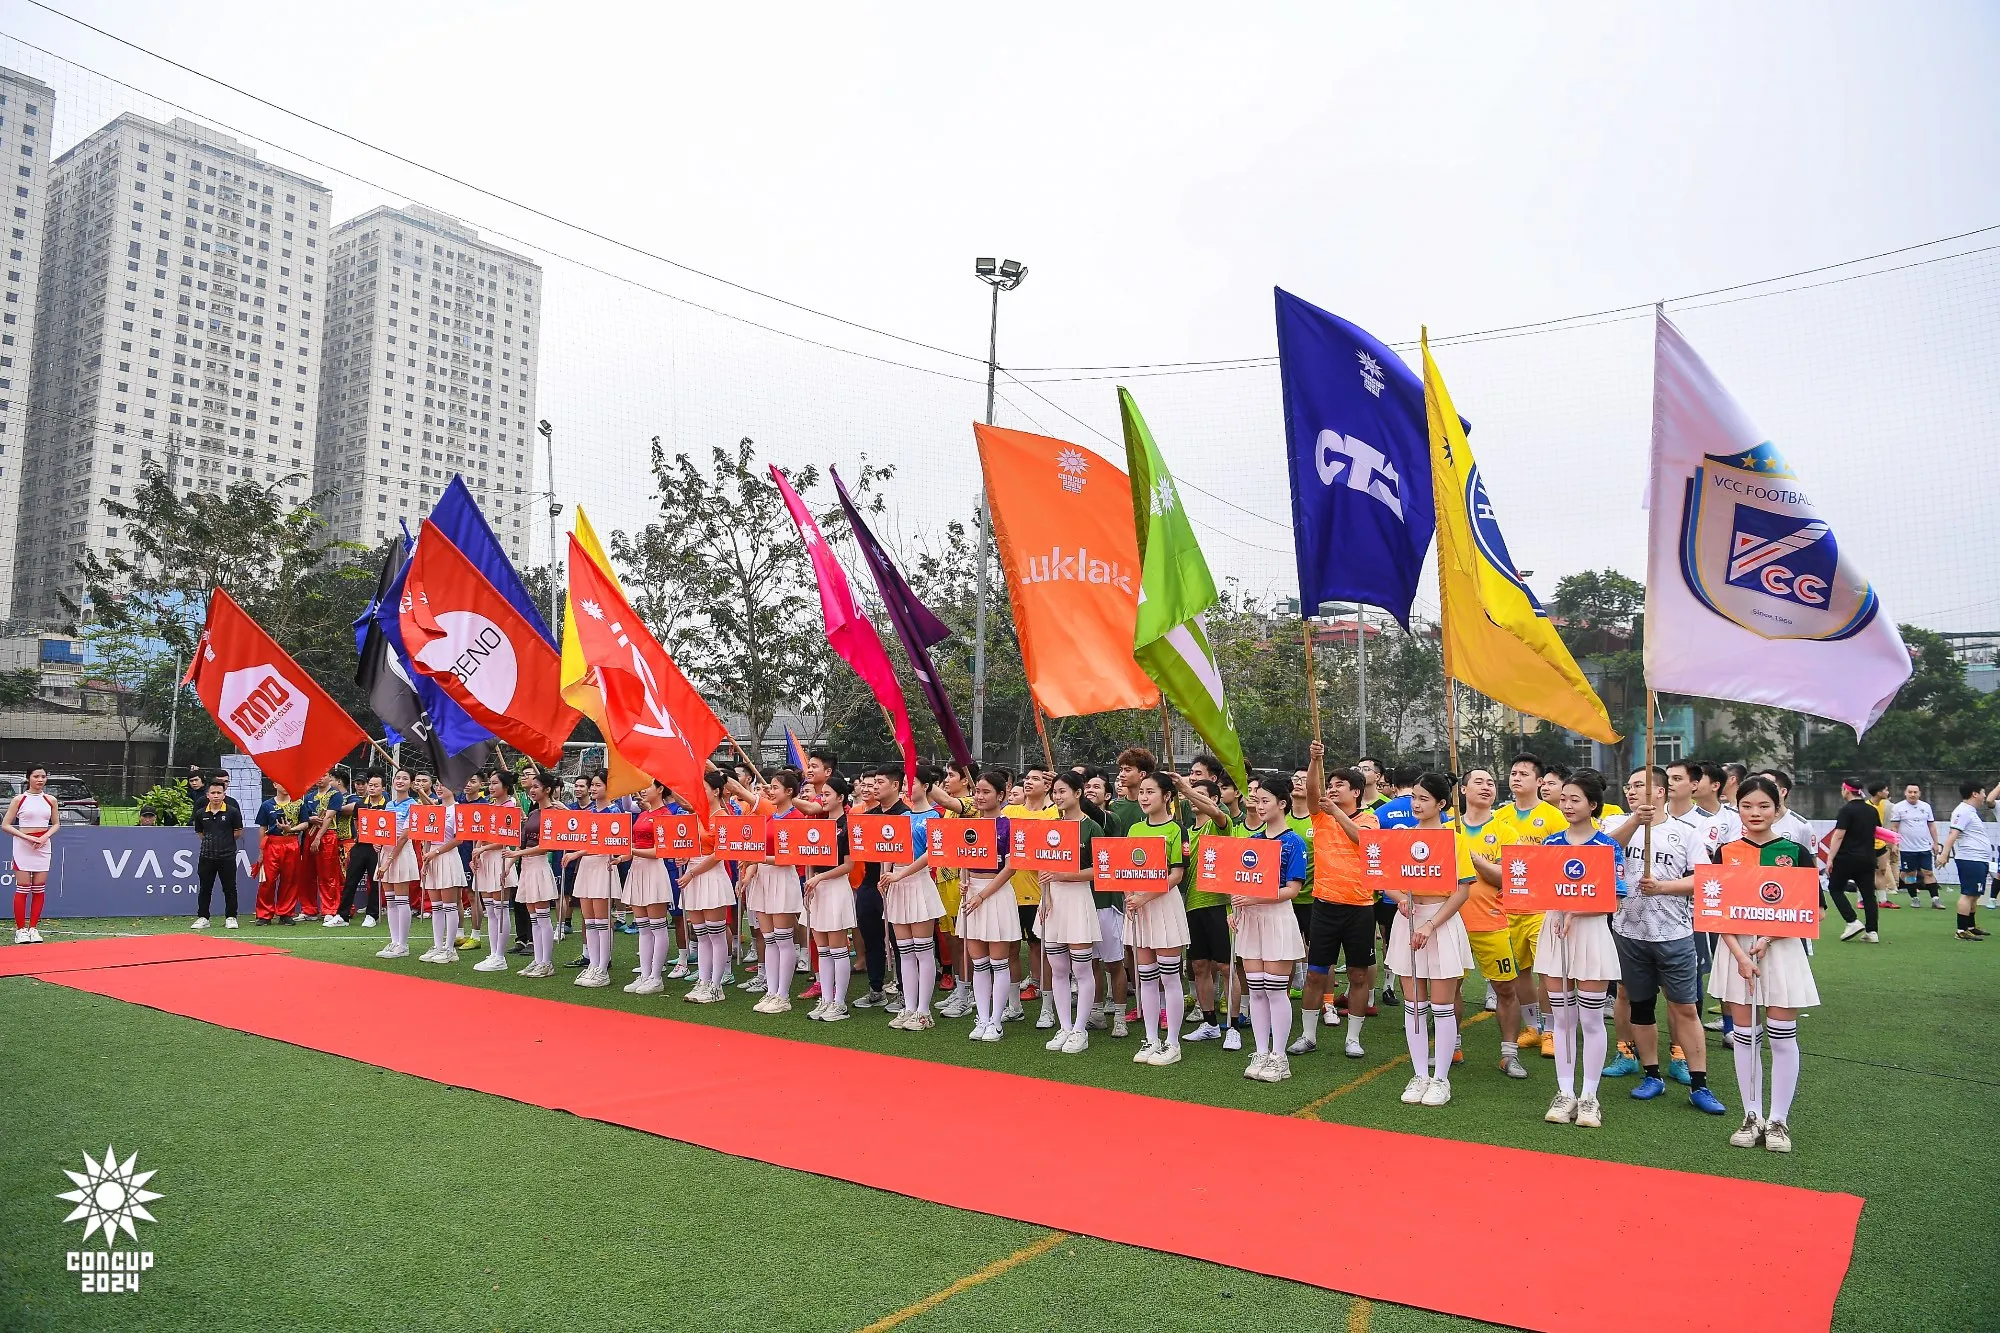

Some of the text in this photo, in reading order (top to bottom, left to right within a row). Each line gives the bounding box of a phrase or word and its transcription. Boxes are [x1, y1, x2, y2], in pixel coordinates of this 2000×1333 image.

[1714, 475, 1816, 507] VCC FOOTBAL
[254, 715, 280, 740] FOOTBALL
[580, 834, 588, 842] FC
[622, 838, 629, 846] FC
[686, 839, 693, 848] FC
[743, 842, 757, 851] ARCH
[757, 842, 765, 851] FC
[895, 843, 903, 852] FC
[978, 847, 988, 857] FC
[1035, 850, 1072, 860] LUKLAK FC
[1655, 852, 1673, 866] FC
[102, 850, 252, 879] VASA
[1401, 864, 1441, 877] HUCE FC
[1121, 869, 1158, 880] CONTRACTING
[1158, 869, 1166, 879] FC
[1235, 871, 1263, 884] CTA FC
[146, 884, 198, 894] STON
[1555, 883, 1596, 897] VCC FC
[1799, 908, 1814, 923] FC
[1496, 957, 1511, 974] 18
